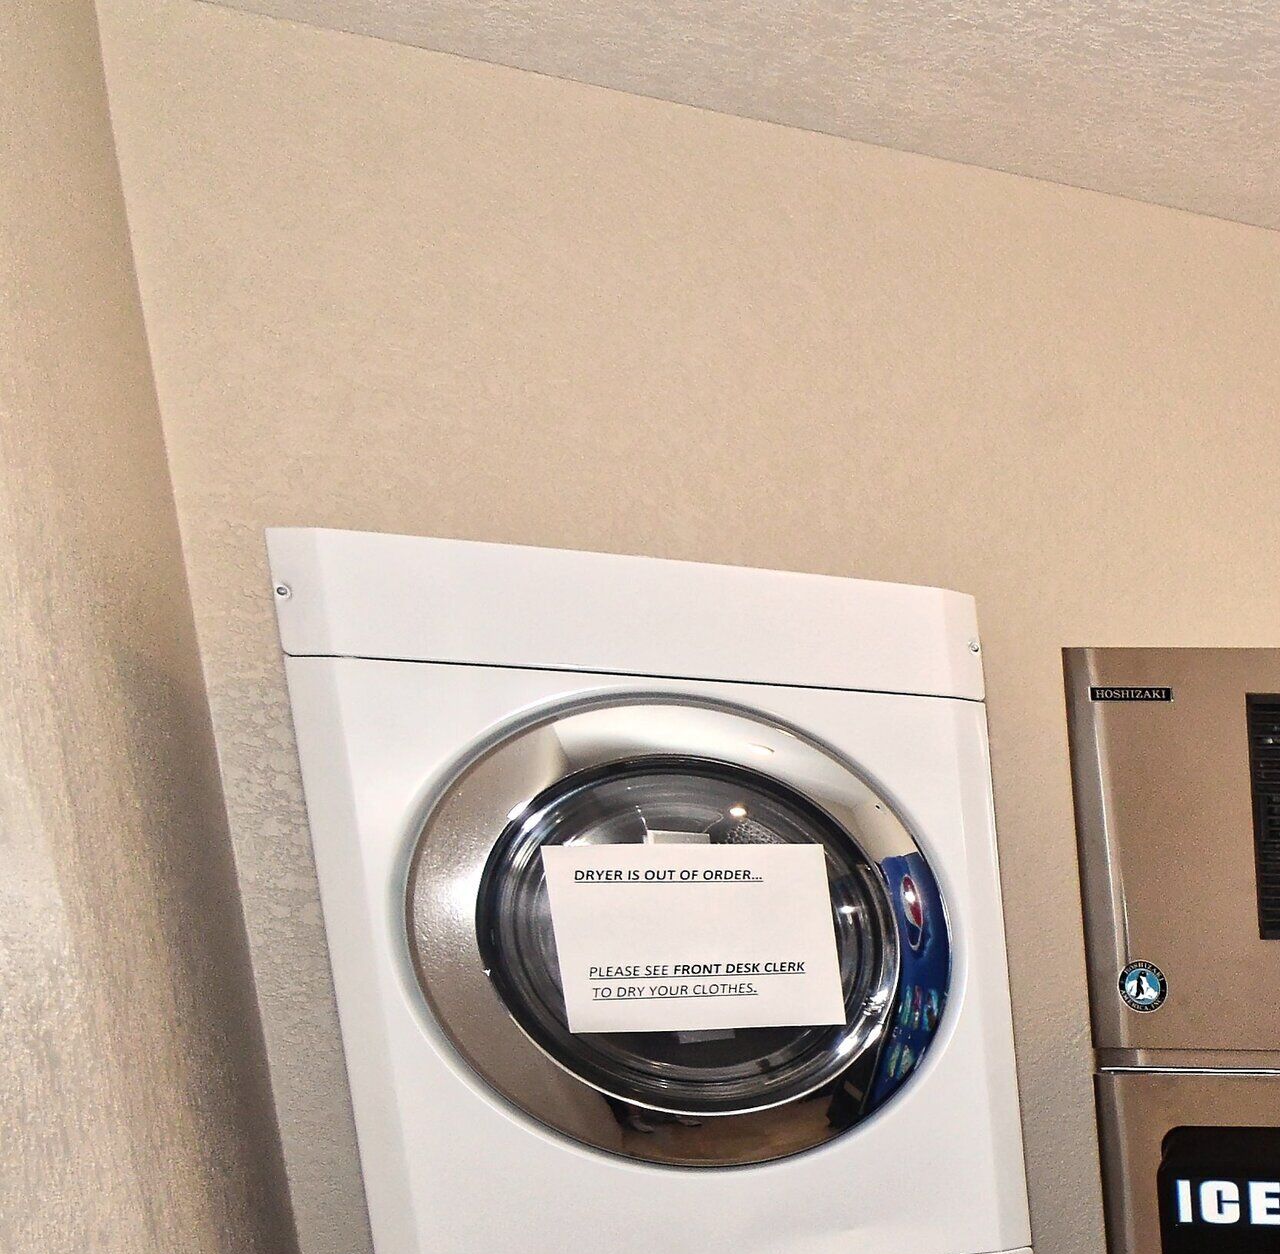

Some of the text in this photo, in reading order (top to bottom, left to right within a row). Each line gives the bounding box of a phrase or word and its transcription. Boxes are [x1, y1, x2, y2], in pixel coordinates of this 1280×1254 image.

[1095, 689, 1167, 699] HOSHIZAKI
[574, 869, 763, 881] DRYER IS OUT OF ORDER...
[589, 961, 805, 978] PLEASE SEE FRONT DESK CLERK
[593, 983, 757, 998] TO DRY YOUR CLOTHES.
